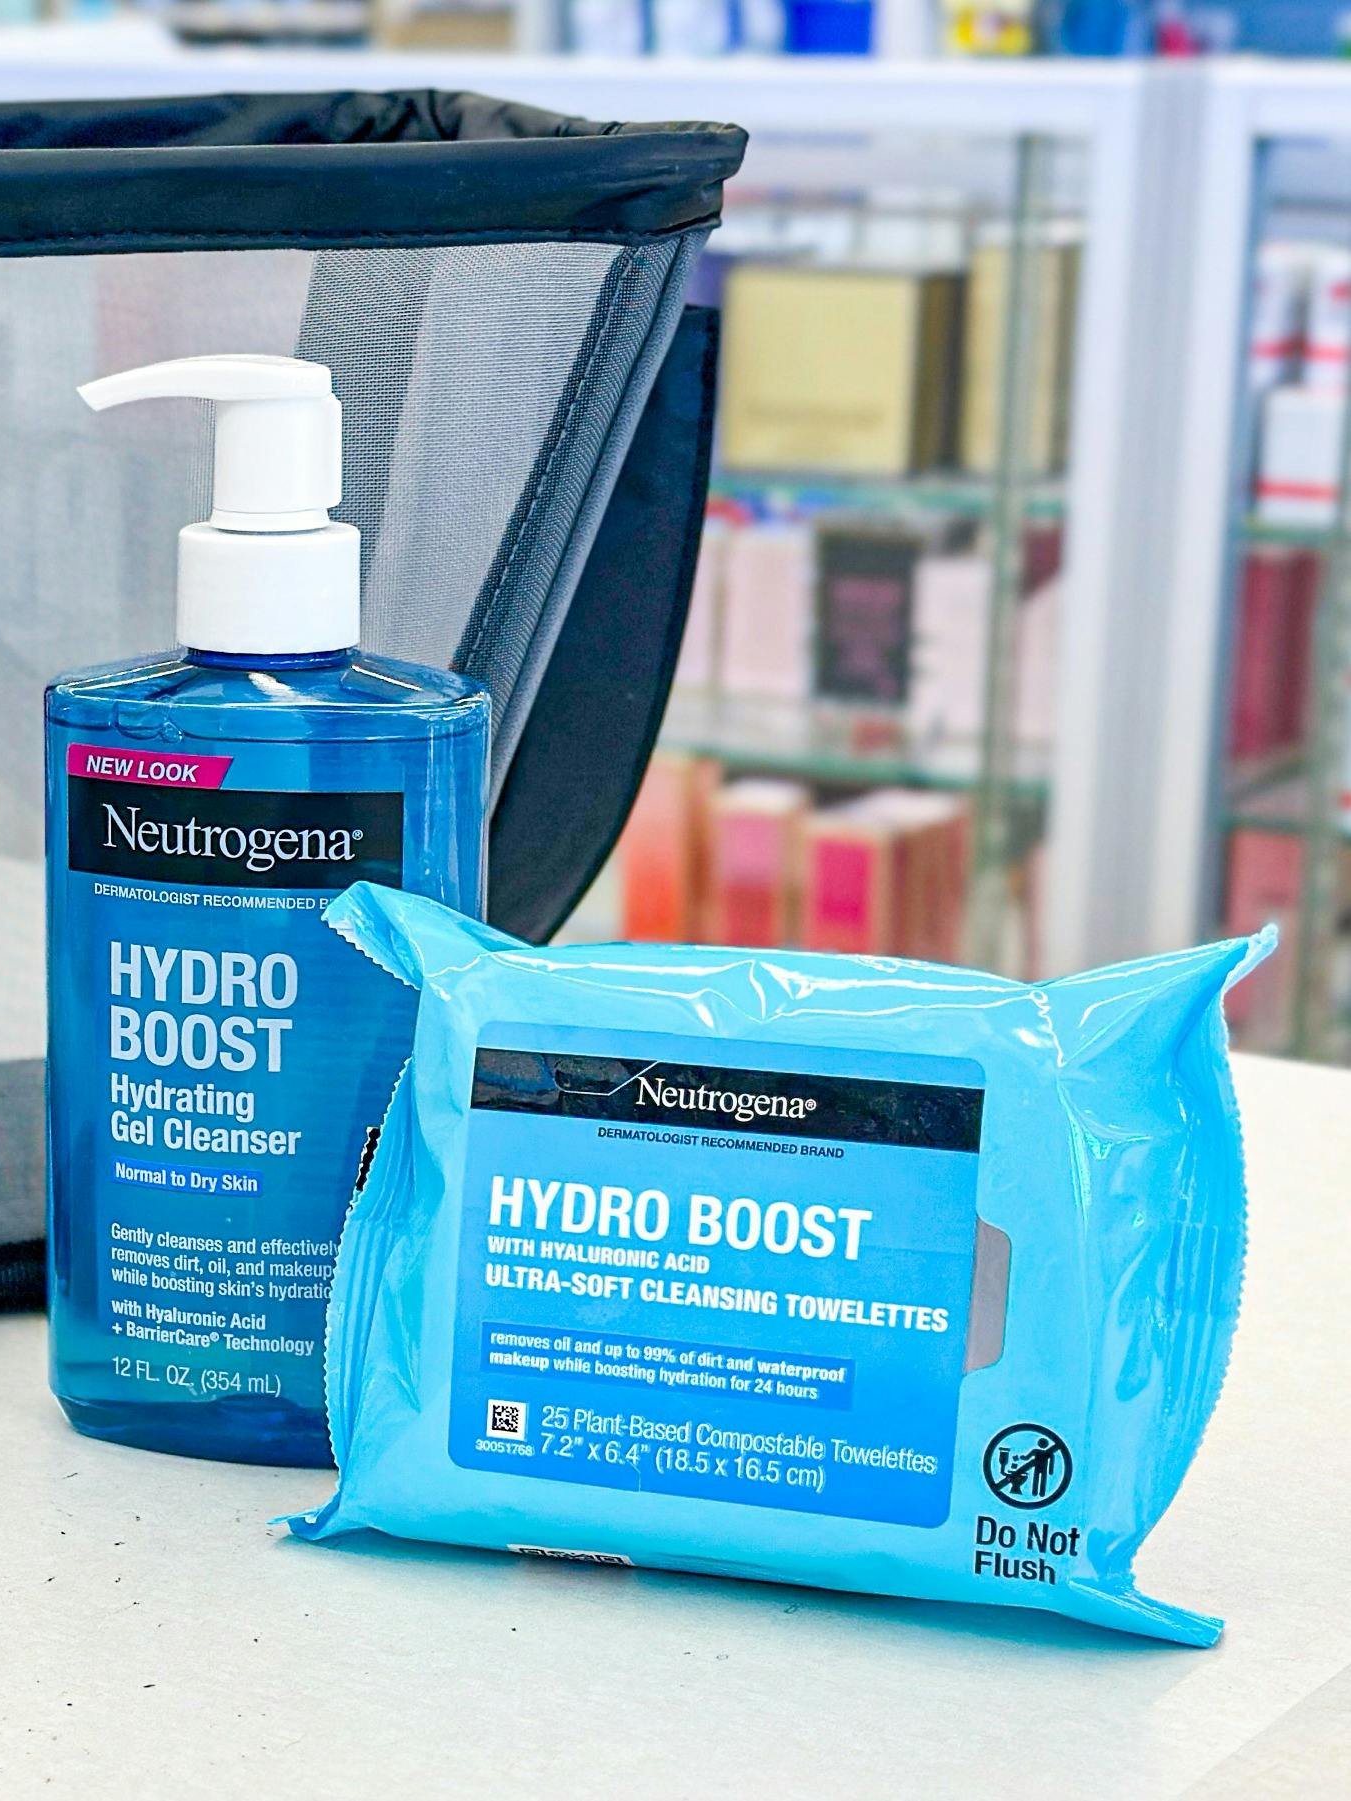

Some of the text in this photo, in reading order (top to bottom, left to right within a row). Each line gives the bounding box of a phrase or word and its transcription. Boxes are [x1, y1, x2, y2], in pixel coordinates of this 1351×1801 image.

[86, 754, 200, 783] NEW LOOK
[102, 803, 363, 872] Neutrogena®
[94, 882, 200, 906] DERMATOLOGIST
[204, 895, 316, 910] RECOMMENDED
[110, 941, 298, 1009] HYDRO
[110, 1005, 293, 1072] BOOST
[111, 1072, 255, 1122] Hydrating
[635, 1076, 817, 1122] Neutrogena®
[111, 1111, 302, 1155] Gel Cleanser
[597, 1126, 844, 1159] DERMATOLOGIST RECOMMENDED BRAND
[115, 1162, 257, 1193] Normal to Dry Skin
[111, 1222, 153, 1247] Gently
[157, 1232, 223, 1253] cleanses
[227, 1238, 256, 1254] and
[488, 1175, 874, 1261] HYDRO BOOST
[111, 1248, 332, 1279] removes dirt, oil, and makeup
[487, 1236, 711, 1274] WITH HYALURONIC ACID
[111, 1268, 147, 1286] while
[151, 1273, 214, 1297] boosting
[269, 1281, 331, 1300] hydratio
[485, 1264, 949, 1333] ULTRA-SOFT CLEANSING TOWELETTES
[111, 1299, 266, 1331] with Hyaluronic Acid
[112, 1322, 314, 1356] + BarrierCare® Technology
[490, 1331, 846, 1383] removes oil and up to 99% of dirt and waterproof
[112, 1356, 281, 1397] 12 FL. OZ. (354 mL)
[489, 1351, 818, 1400] makeup while boosting hydration for 24 hours
[542, 1405, 938, 1475] 25 Plant-Based Compostable Towelettes
[587, 1442, 599, 1459] x
[655, 1449, 710, 1473] (18.5
[714, 1457, 728, 1475] x
[735, 1456, 780, 1483] 16.5
[786, 1465, 826, 1493] cm)
[976, 1516, 1080, 1556] Do Not
[975, 1551, 1055, 1585] Flush
